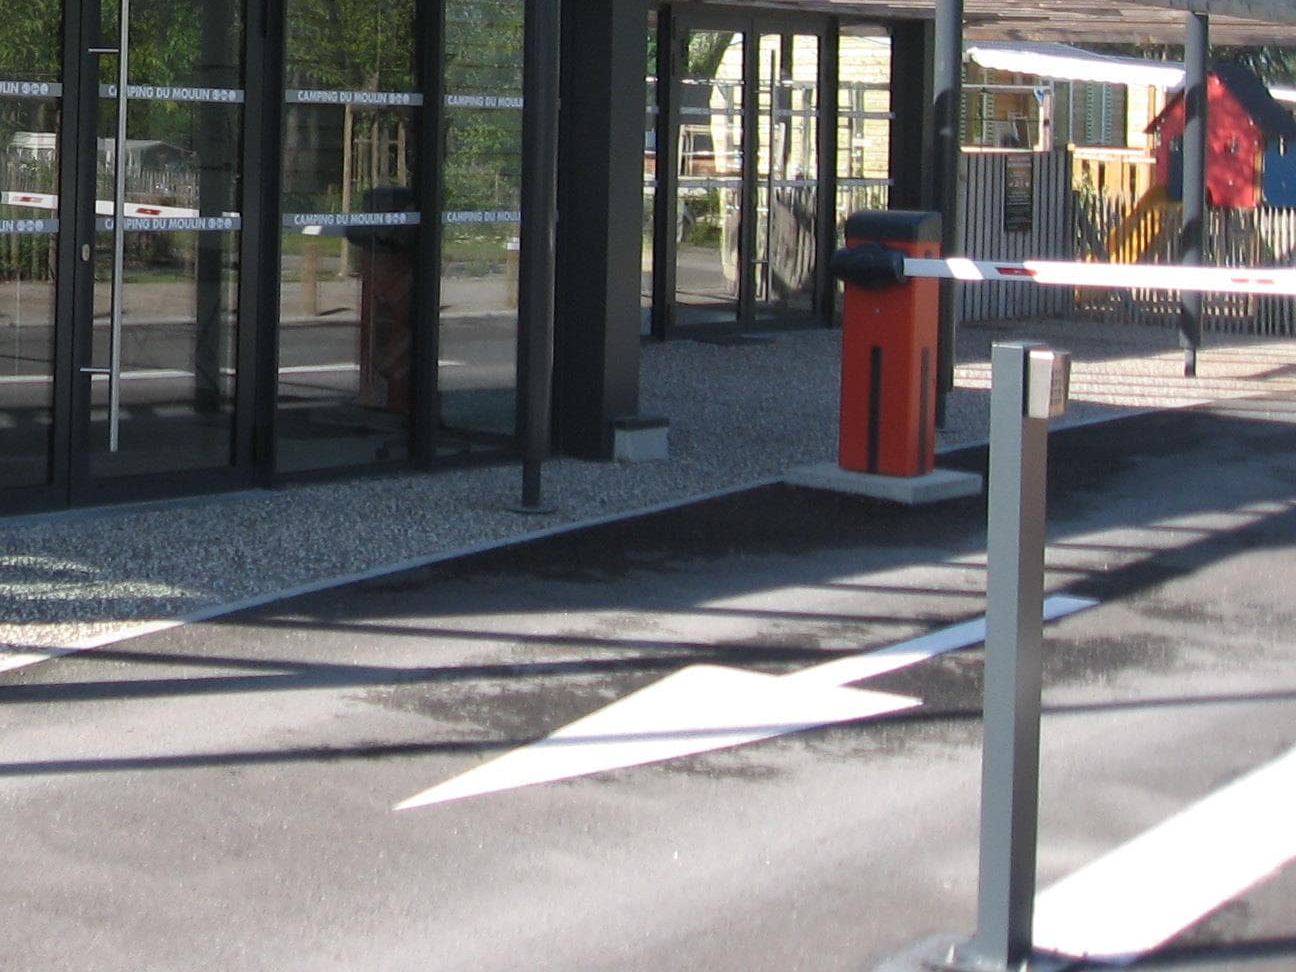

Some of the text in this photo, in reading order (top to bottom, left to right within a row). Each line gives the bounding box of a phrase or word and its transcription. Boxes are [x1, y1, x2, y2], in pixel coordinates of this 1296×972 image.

[108, 85, 210, 100] CPING DU MOULIN
[297, 90, 386, 103] CAMPING DU MOULIN
[447, 95, 483, 107] CAMPING
[485, 96, 497, 107] DU
[294, 213, 383, 225] CAMPING DU MOULIN
[447, 211, 521, 223] CAMPING DU MOULI
[104, 218, 206, 229] CPING DU MOULIN
